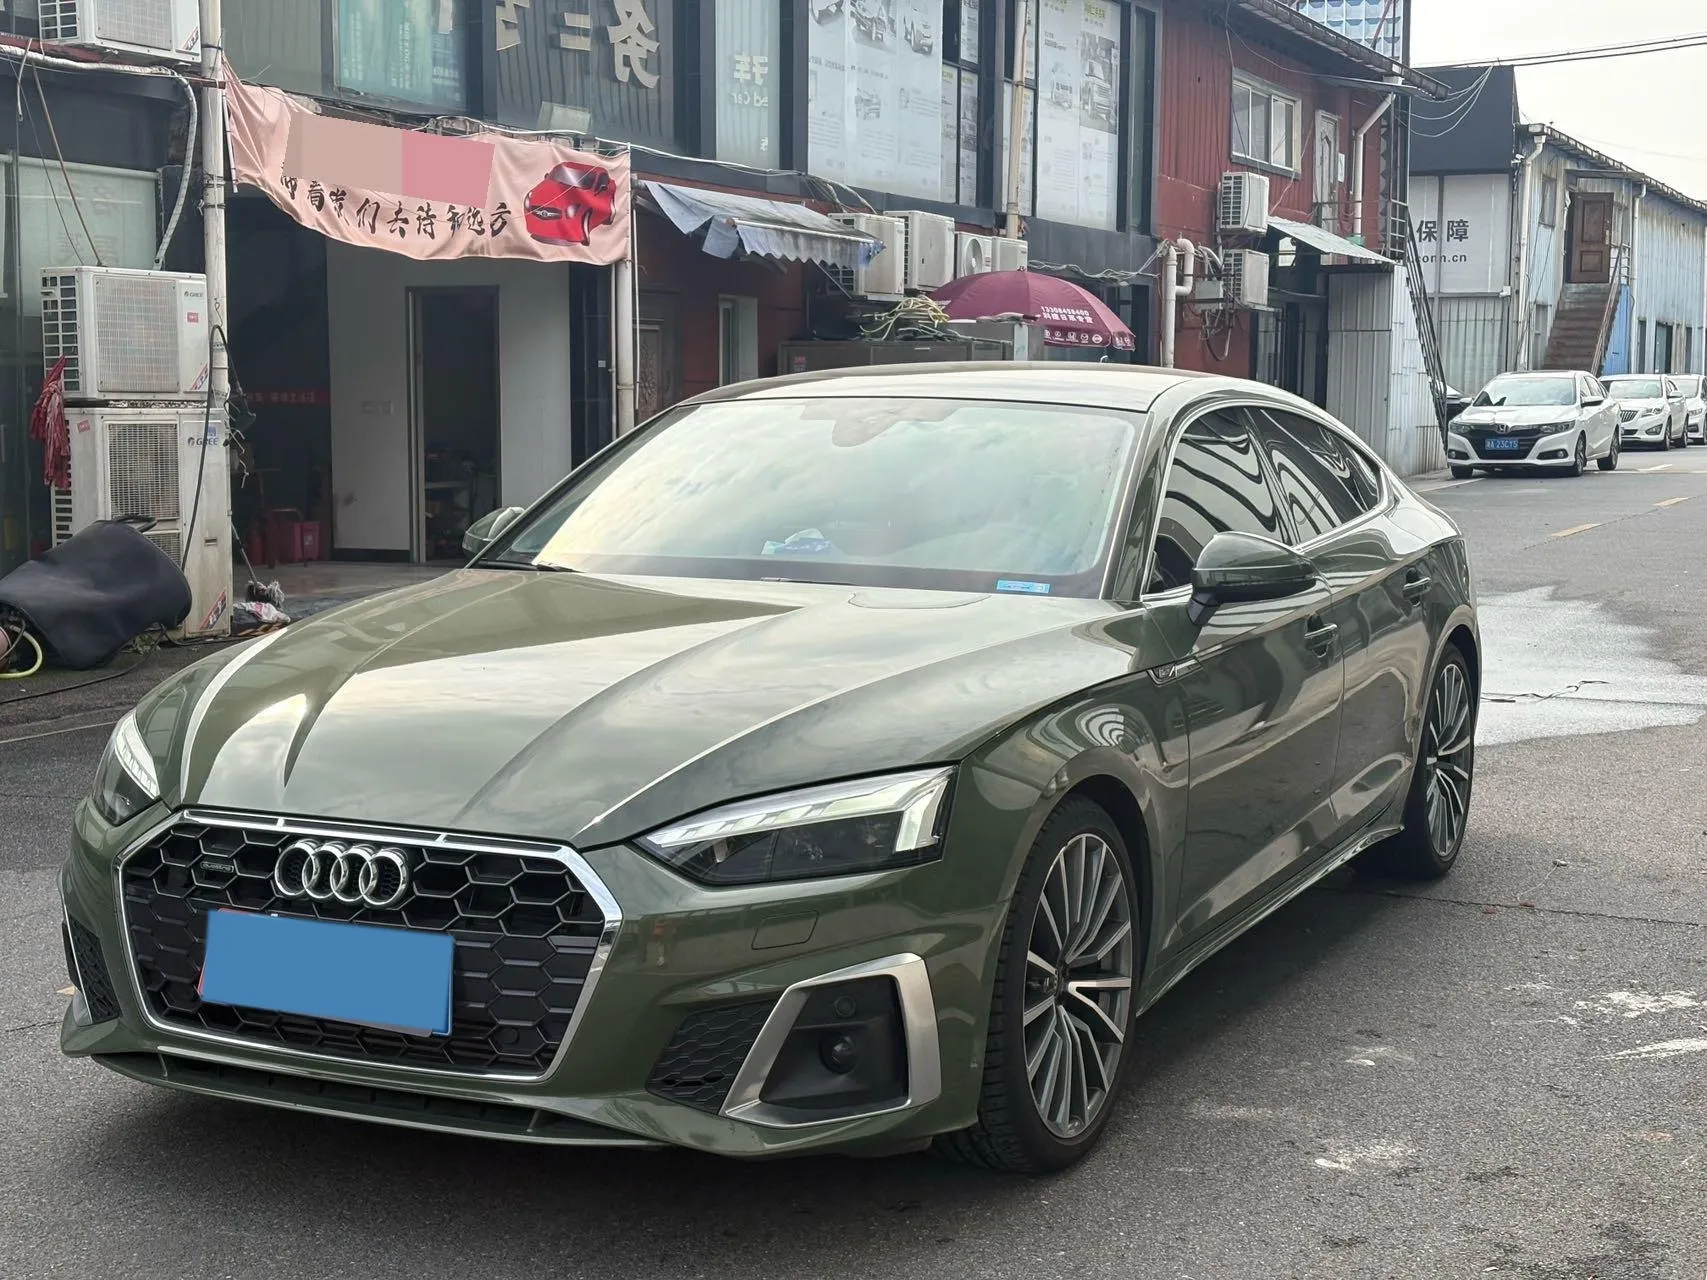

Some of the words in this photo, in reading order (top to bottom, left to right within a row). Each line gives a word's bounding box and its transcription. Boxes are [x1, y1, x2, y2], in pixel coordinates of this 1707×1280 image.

[1416, 219, 1469, 242] 保障
[1418, 254, 1467, 263] om.cn
[196, 437, 219, 446] GEE
